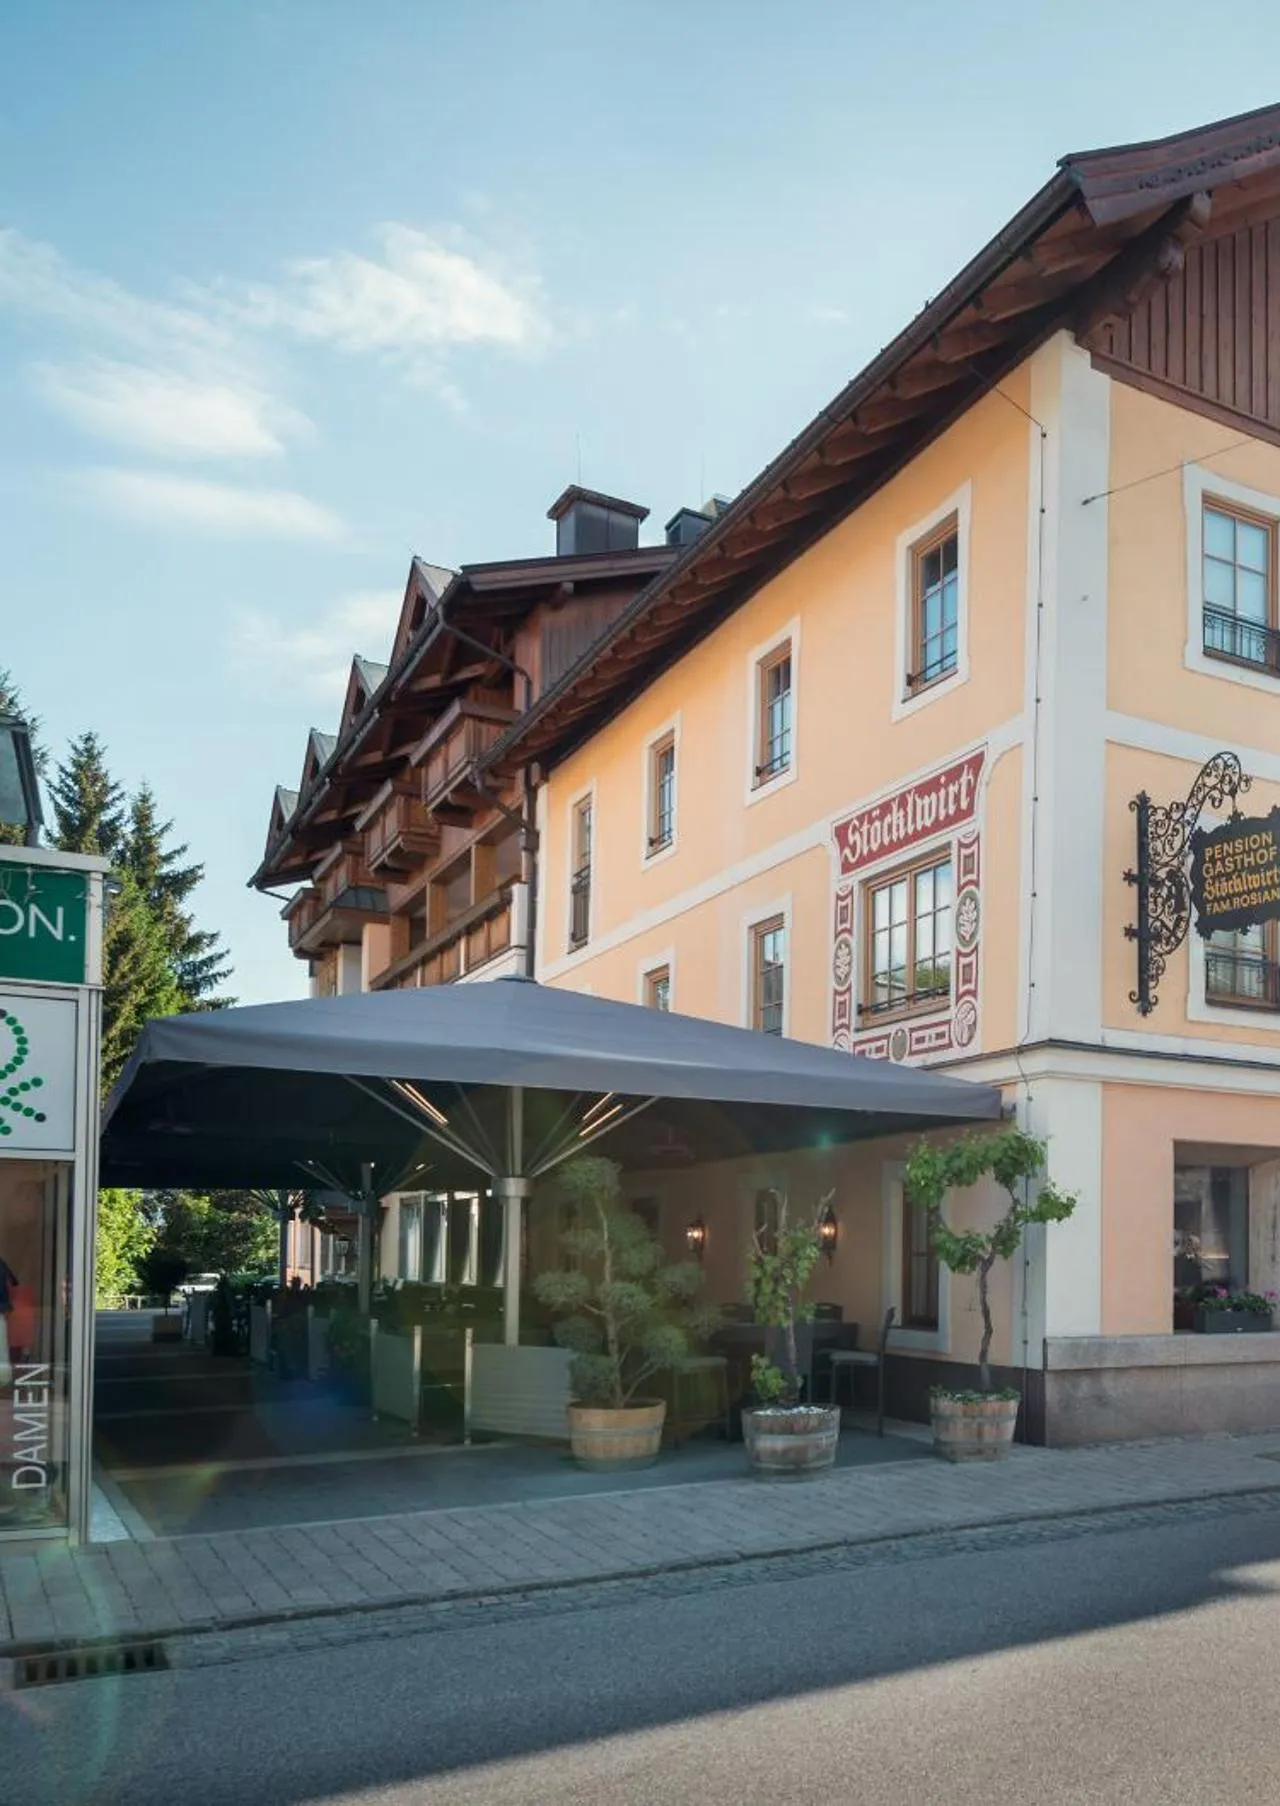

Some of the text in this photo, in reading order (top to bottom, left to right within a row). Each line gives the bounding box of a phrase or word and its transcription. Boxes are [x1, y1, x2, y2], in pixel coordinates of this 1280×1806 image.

[842, 764, 974, 864] Stöcklwirt
[1204, 831, 1273, 861] PENSION
[1202, 845, 1278, 878] GASTHOF
[12, 1363, 50, 1489] DAMEN
